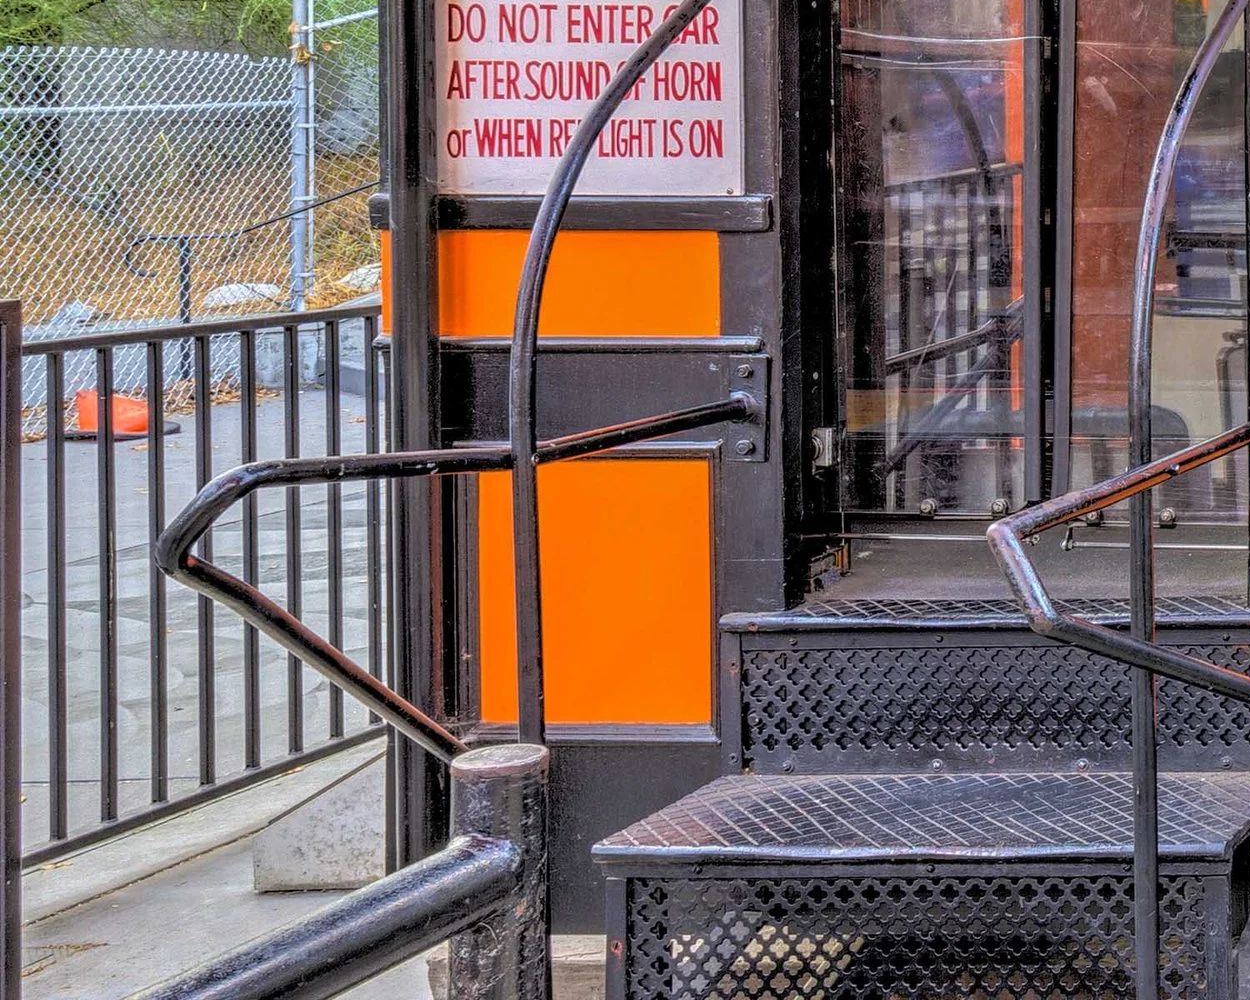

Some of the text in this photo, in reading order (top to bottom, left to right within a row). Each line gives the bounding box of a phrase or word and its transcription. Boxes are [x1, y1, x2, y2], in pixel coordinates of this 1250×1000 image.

[448, 3, 486, 43] DO
[498, 4, 558, 43] NOT
[567, 5, 653, 44] ENTER
[447, 60, 519, 99] AFTER
[523, 61, 611, 100] SOUND
[654, 61, 723, 101] HORN
[446, 119, 723, 158] or WHEN RE LIGHT IS ON
